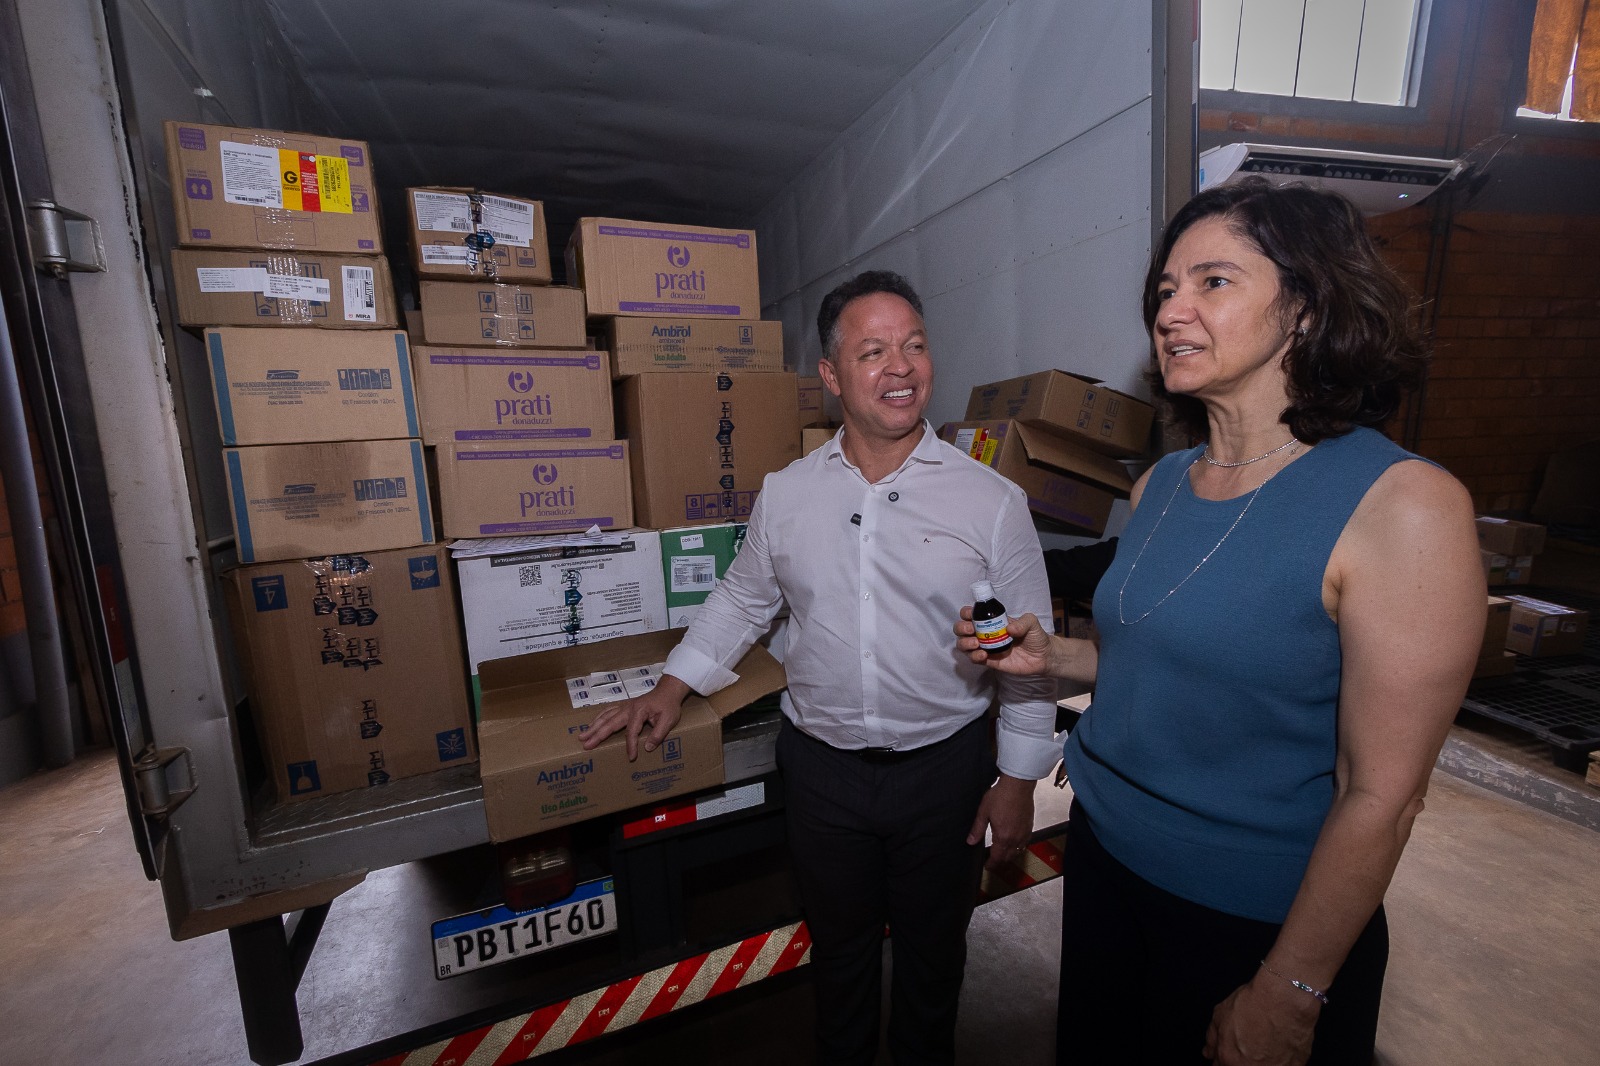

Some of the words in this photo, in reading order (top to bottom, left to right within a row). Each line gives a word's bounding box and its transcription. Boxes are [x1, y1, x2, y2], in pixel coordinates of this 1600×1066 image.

[284, 170, 298, 184] G
[655, 270, 706, 299] prati
[651, 325, 691, 337] Ambrol
[743, 328, 749, 338] 8
[654, 353, 665, 361] Uso
[666, 353, 687, 361] Adulto
[495, 394, 552, 425] prati
[512, 417, 553, 425] donaduzzi
[972, 441, 978, 450] G
[519, 485, 575, 517] prati
[690, 497, 698, 507] 8
[535, 507, 576, 517] donaduzzi
[667, 741, 676, 752] 8
[536, 758, 594, 786] Ambrol
[541, 799, 557, 814] Uso
[558, 795, 588, 812] Adulto
[453, 899, 606, 968] PBT1F60
[440, 964, 452, 975] BR
